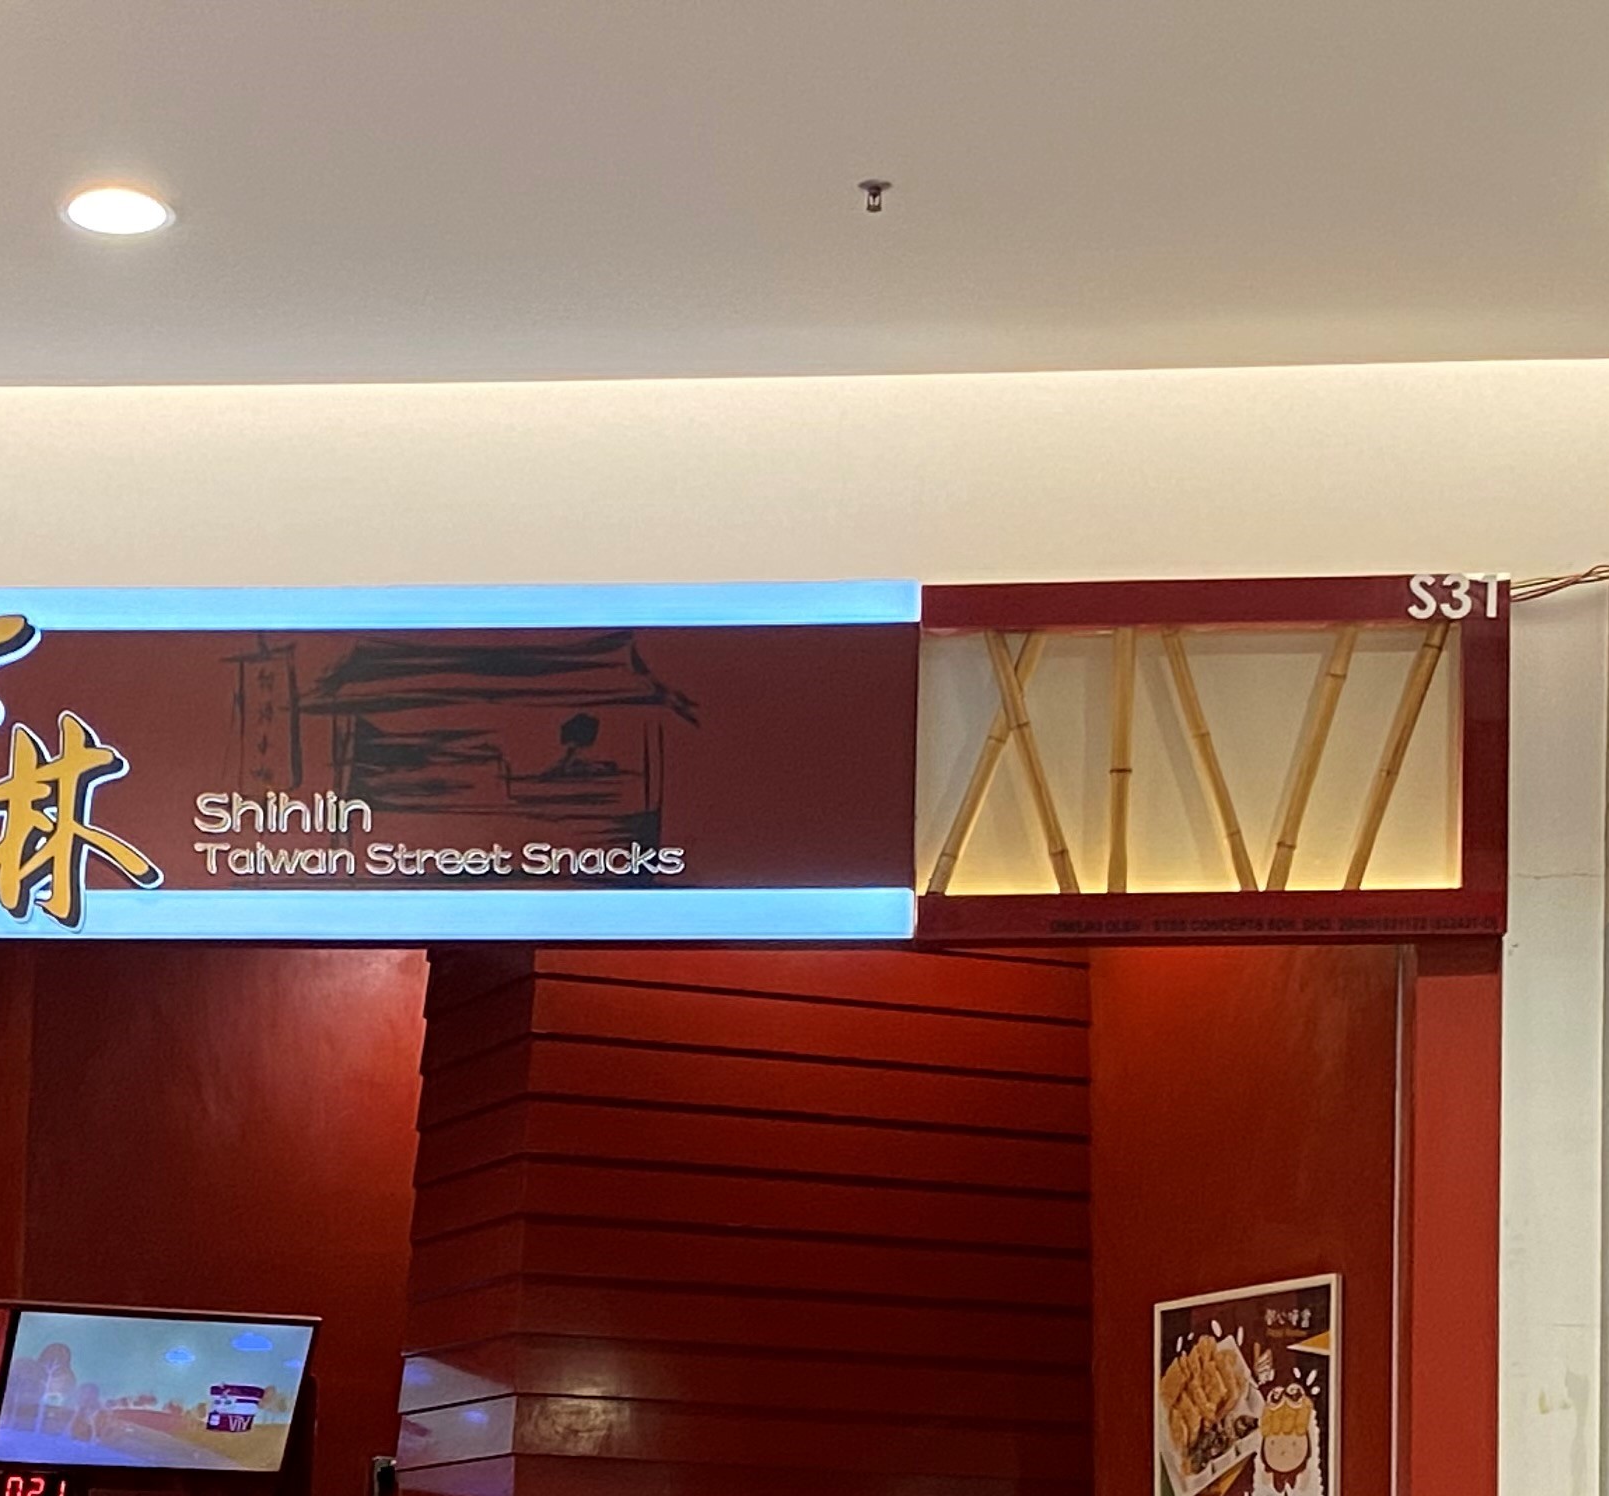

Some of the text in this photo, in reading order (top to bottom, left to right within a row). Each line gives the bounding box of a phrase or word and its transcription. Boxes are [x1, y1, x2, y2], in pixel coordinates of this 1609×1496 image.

[193, 791, 373, 833] Shihlin
[193, 842, 686, 876] Taiwan Street Snacks
